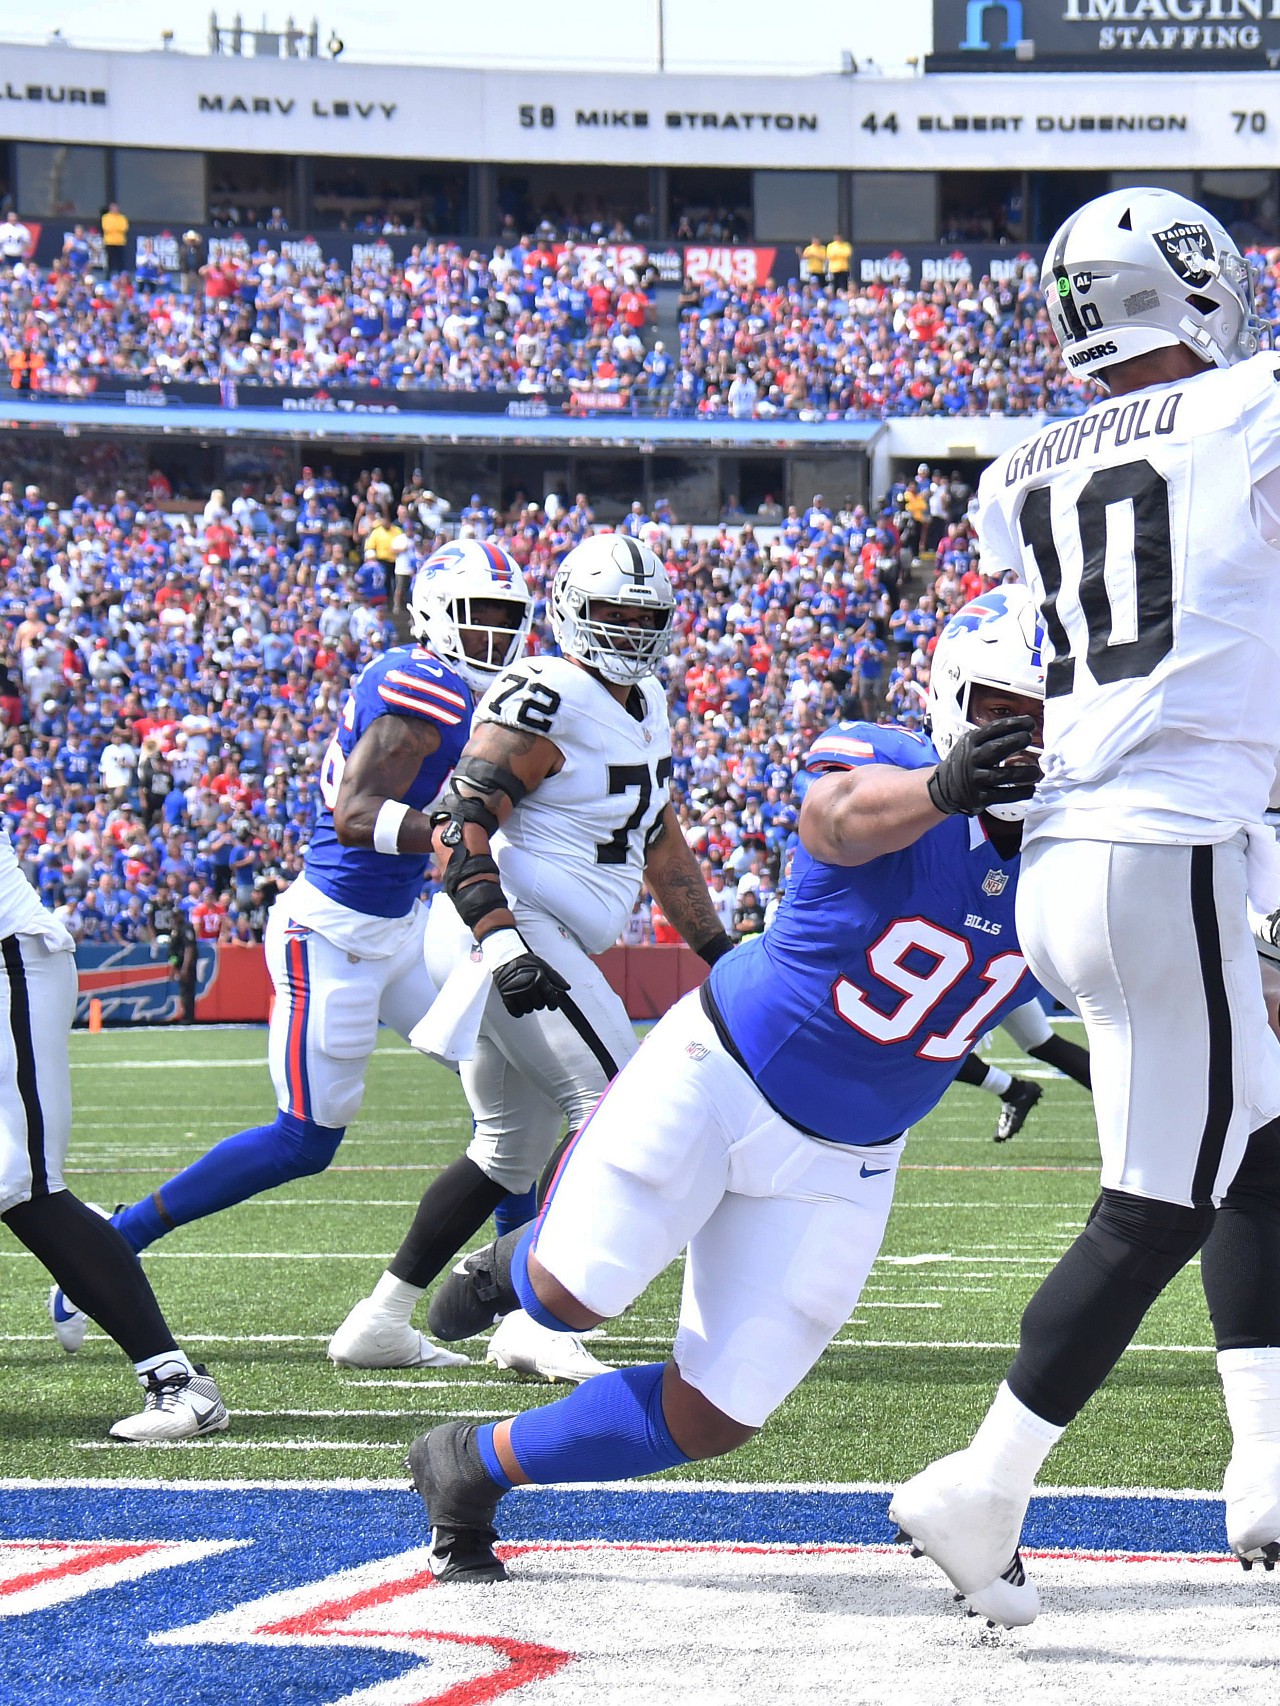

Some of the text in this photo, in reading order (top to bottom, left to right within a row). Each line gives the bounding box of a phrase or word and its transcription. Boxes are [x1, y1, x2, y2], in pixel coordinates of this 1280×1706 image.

[1099, 26, 1262, 49] STAFFING
[0, 84, 107, 106] LEURE
[198, 95, 397, 120] MARV LEVY
[519, 104, 818, 131] 58 MIKE STRATTON
[861, 111, 1187, 134] 44 ELBERT DUBENION
[1231, 111, 1267, 134] 70
[1158, 225, 1203, 241] RAIDERS
[686, 248, 757, 282] 243
[861, 259, 911, 282] Blue
[922, 259, 972, 282] Blue
[1077, 275, 1091, 288] AL
[1068, 341, 1118, 368] RAIDERS
[1005, 393, 1183, 487] GAROPPOLO
[1018, 457, 1175, 700] 10
[488, 673, 562, 733] 72
[963, 913, 1003, 936] BILLS
[832, 915, 1029, 1063] 91
